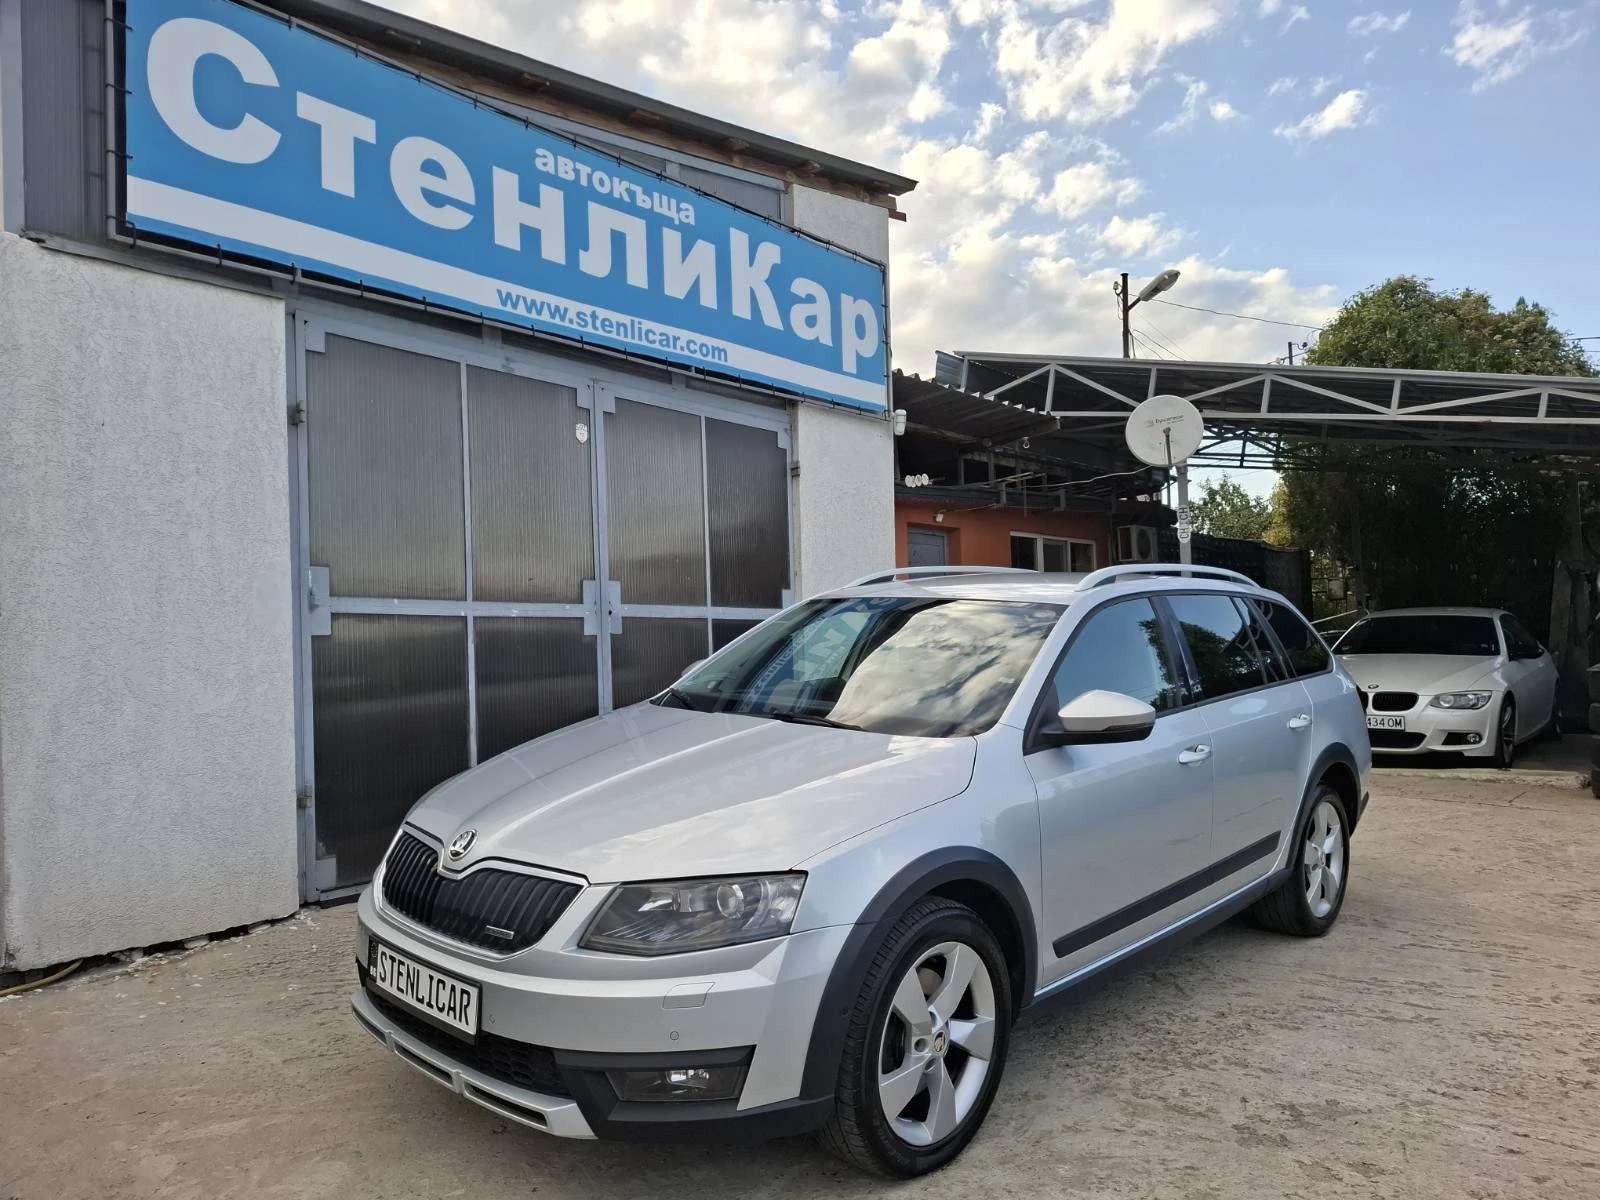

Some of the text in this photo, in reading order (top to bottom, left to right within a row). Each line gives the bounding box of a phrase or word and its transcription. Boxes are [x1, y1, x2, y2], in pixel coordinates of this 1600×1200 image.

[146, 18, 879, 374] СтенлиКар
[535, 147, 696, 226] автокъща
[496, 287, 729, 364] www.stenlicar.com
[379, 951, 471, 1026] STENLICAR
